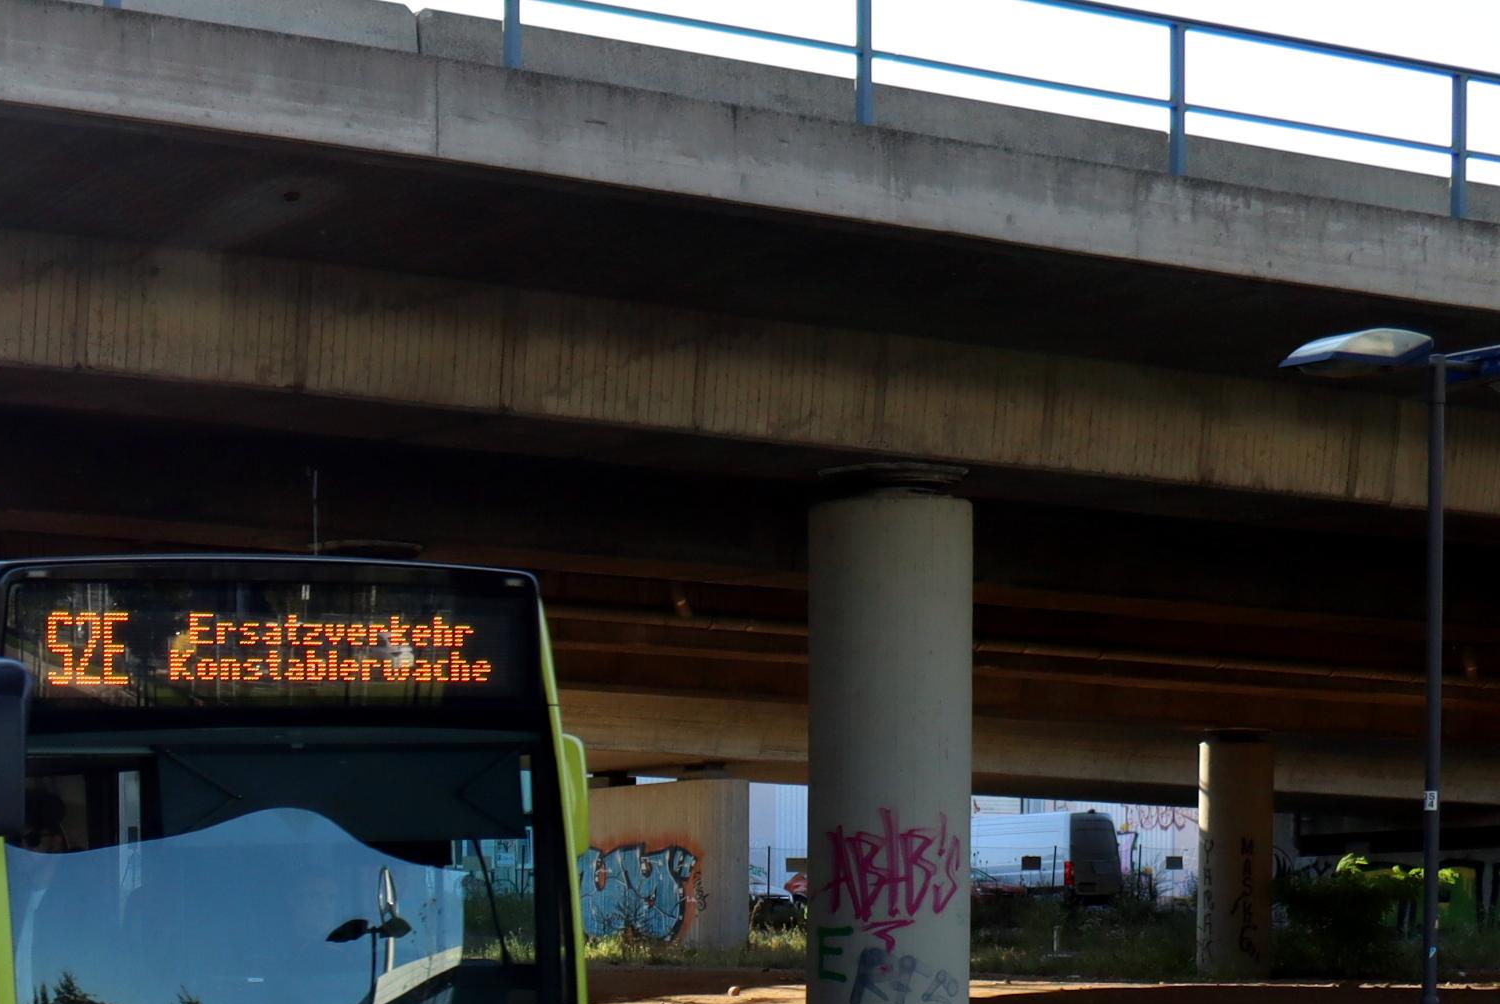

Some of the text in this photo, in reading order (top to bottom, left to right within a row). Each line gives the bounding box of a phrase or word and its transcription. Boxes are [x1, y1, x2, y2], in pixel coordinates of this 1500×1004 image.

[188, 612, 475, 648] Ersatzverkehr
[46, 611, 129, 686] S2E
[168, 649, 493, 684] Konstablerwache
